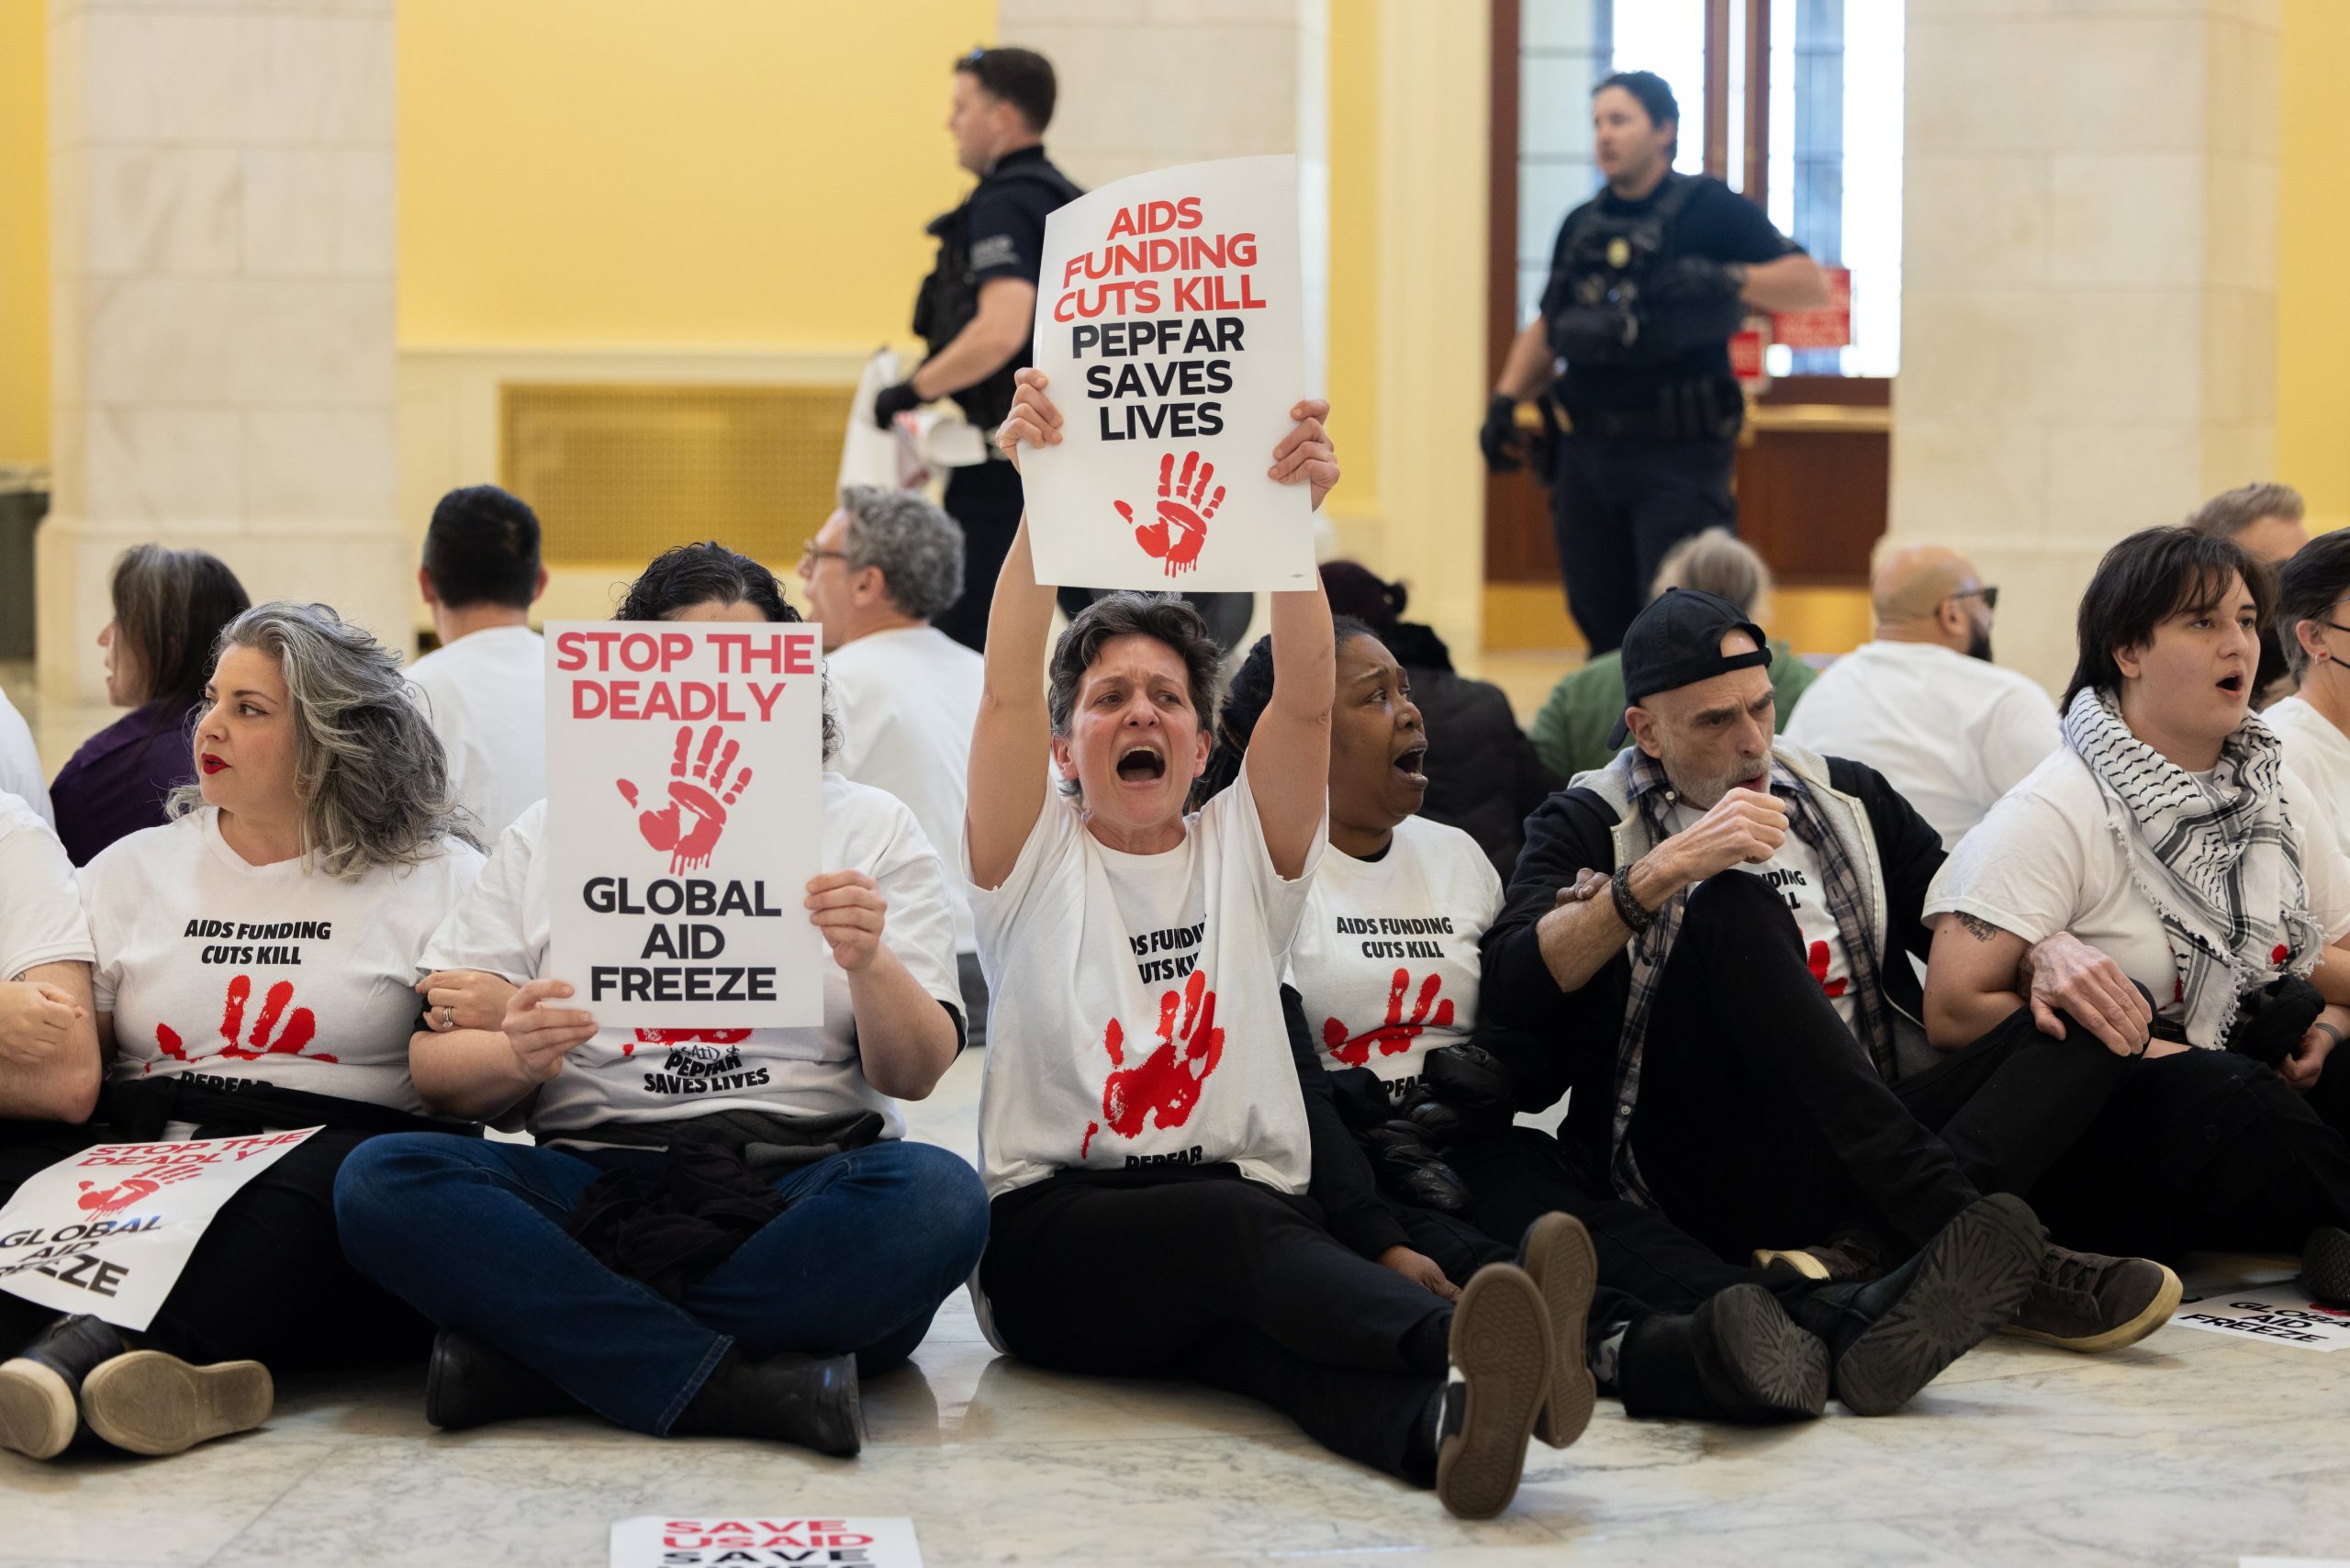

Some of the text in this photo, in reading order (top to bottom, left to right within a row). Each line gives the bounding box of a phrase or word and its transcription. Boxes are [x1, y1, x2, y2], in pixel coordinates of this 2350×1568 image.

[1107, 196, 1203, 241] AIDS
[1063, 233, 1257, 289] FUNDING
[1054, 274, 1266, 322] CUTS KILL
[1073, 317, 1245, 359] PEPFAR
[1086, 360, 1233, 398] SAVES
[1100, 402, 1224, 441] LIVES
[556, 632, 814, 674] STOP THE
[572, 680, 787, 722] DEADLY
[583, 877, 781, 917] GLOBAL
[184, 919, 331, 940] AIDS FUNDING
[1337, 916, 1454, 935] AIDS FUNDING
[201, 946, 301, 965] CUTS KILL
[640, 924, 725, 959] AID
[1361, 941, 1445, 958] CUTS KILL
[591, 966, 777, 1001] FREEZE
[1138, 958, 1174, 984] UTS
[643, 1068, 770, 1094] SAVES LIVES
[77, 1148, 272, 1167] DEADLY
[88, 1130, 314, 1157] STOP THE
[0, 1215, 162, 1249] GLOBAL
[19, 1241, 99, 1262] AID
[2178, 1314, 2330, 1343] FREEZE
[2240, 1315, 2312, 1328] AID
[665, 1520, 847, 1534] SAVE
[663, 1534, 874, 1549] USAID
[663, 1549, 869, 1564] SAVE
